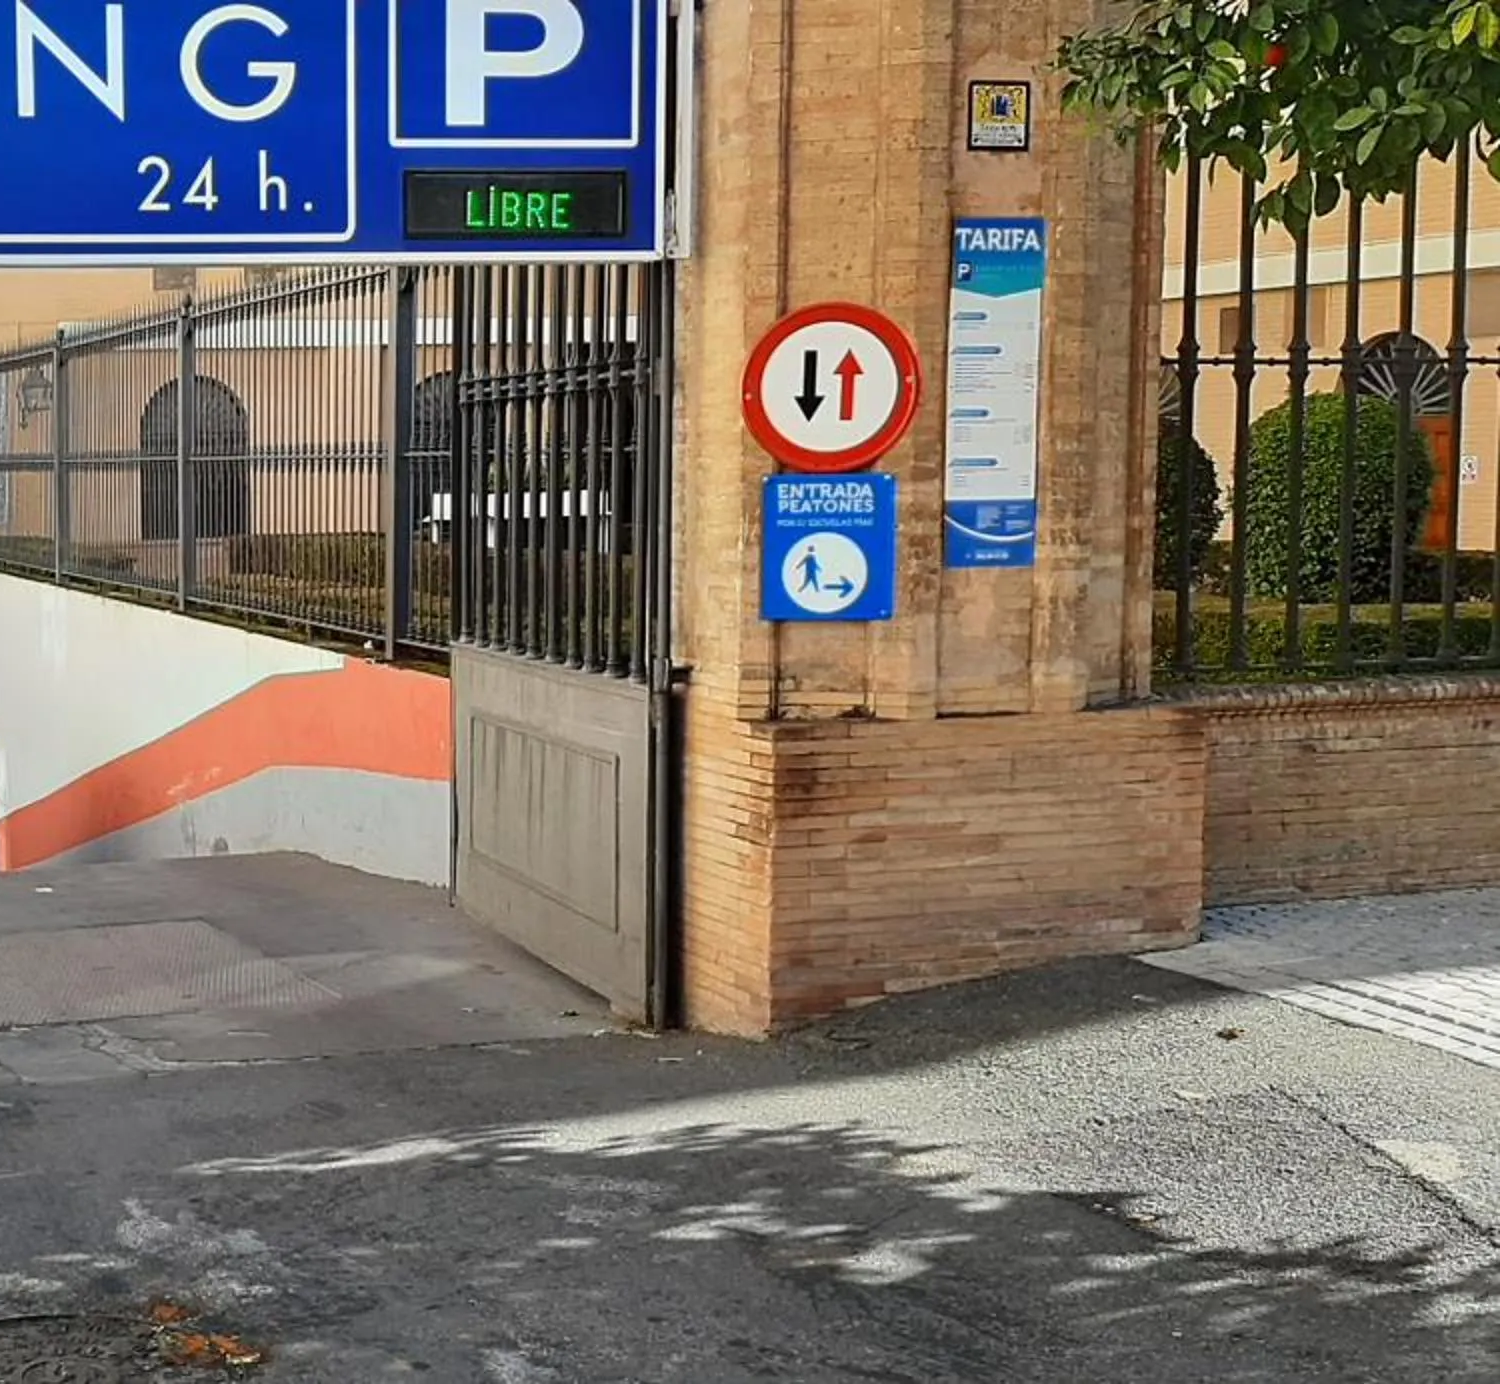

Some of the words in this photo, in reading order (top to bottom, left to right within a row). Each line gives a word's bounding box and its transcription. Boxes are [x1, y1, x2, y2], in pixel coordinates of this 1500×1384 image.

[445, 0, 585, 127] P
[136, 154, 219, 213] 24
[259, 149, 313, 213] h.
[955, 227, 1041, 251] TARIFA
[957, 264, 970, 280] P
[777, 482, 874, 499] ENTRADA
[778, 499, 875, 513] PEATONES
